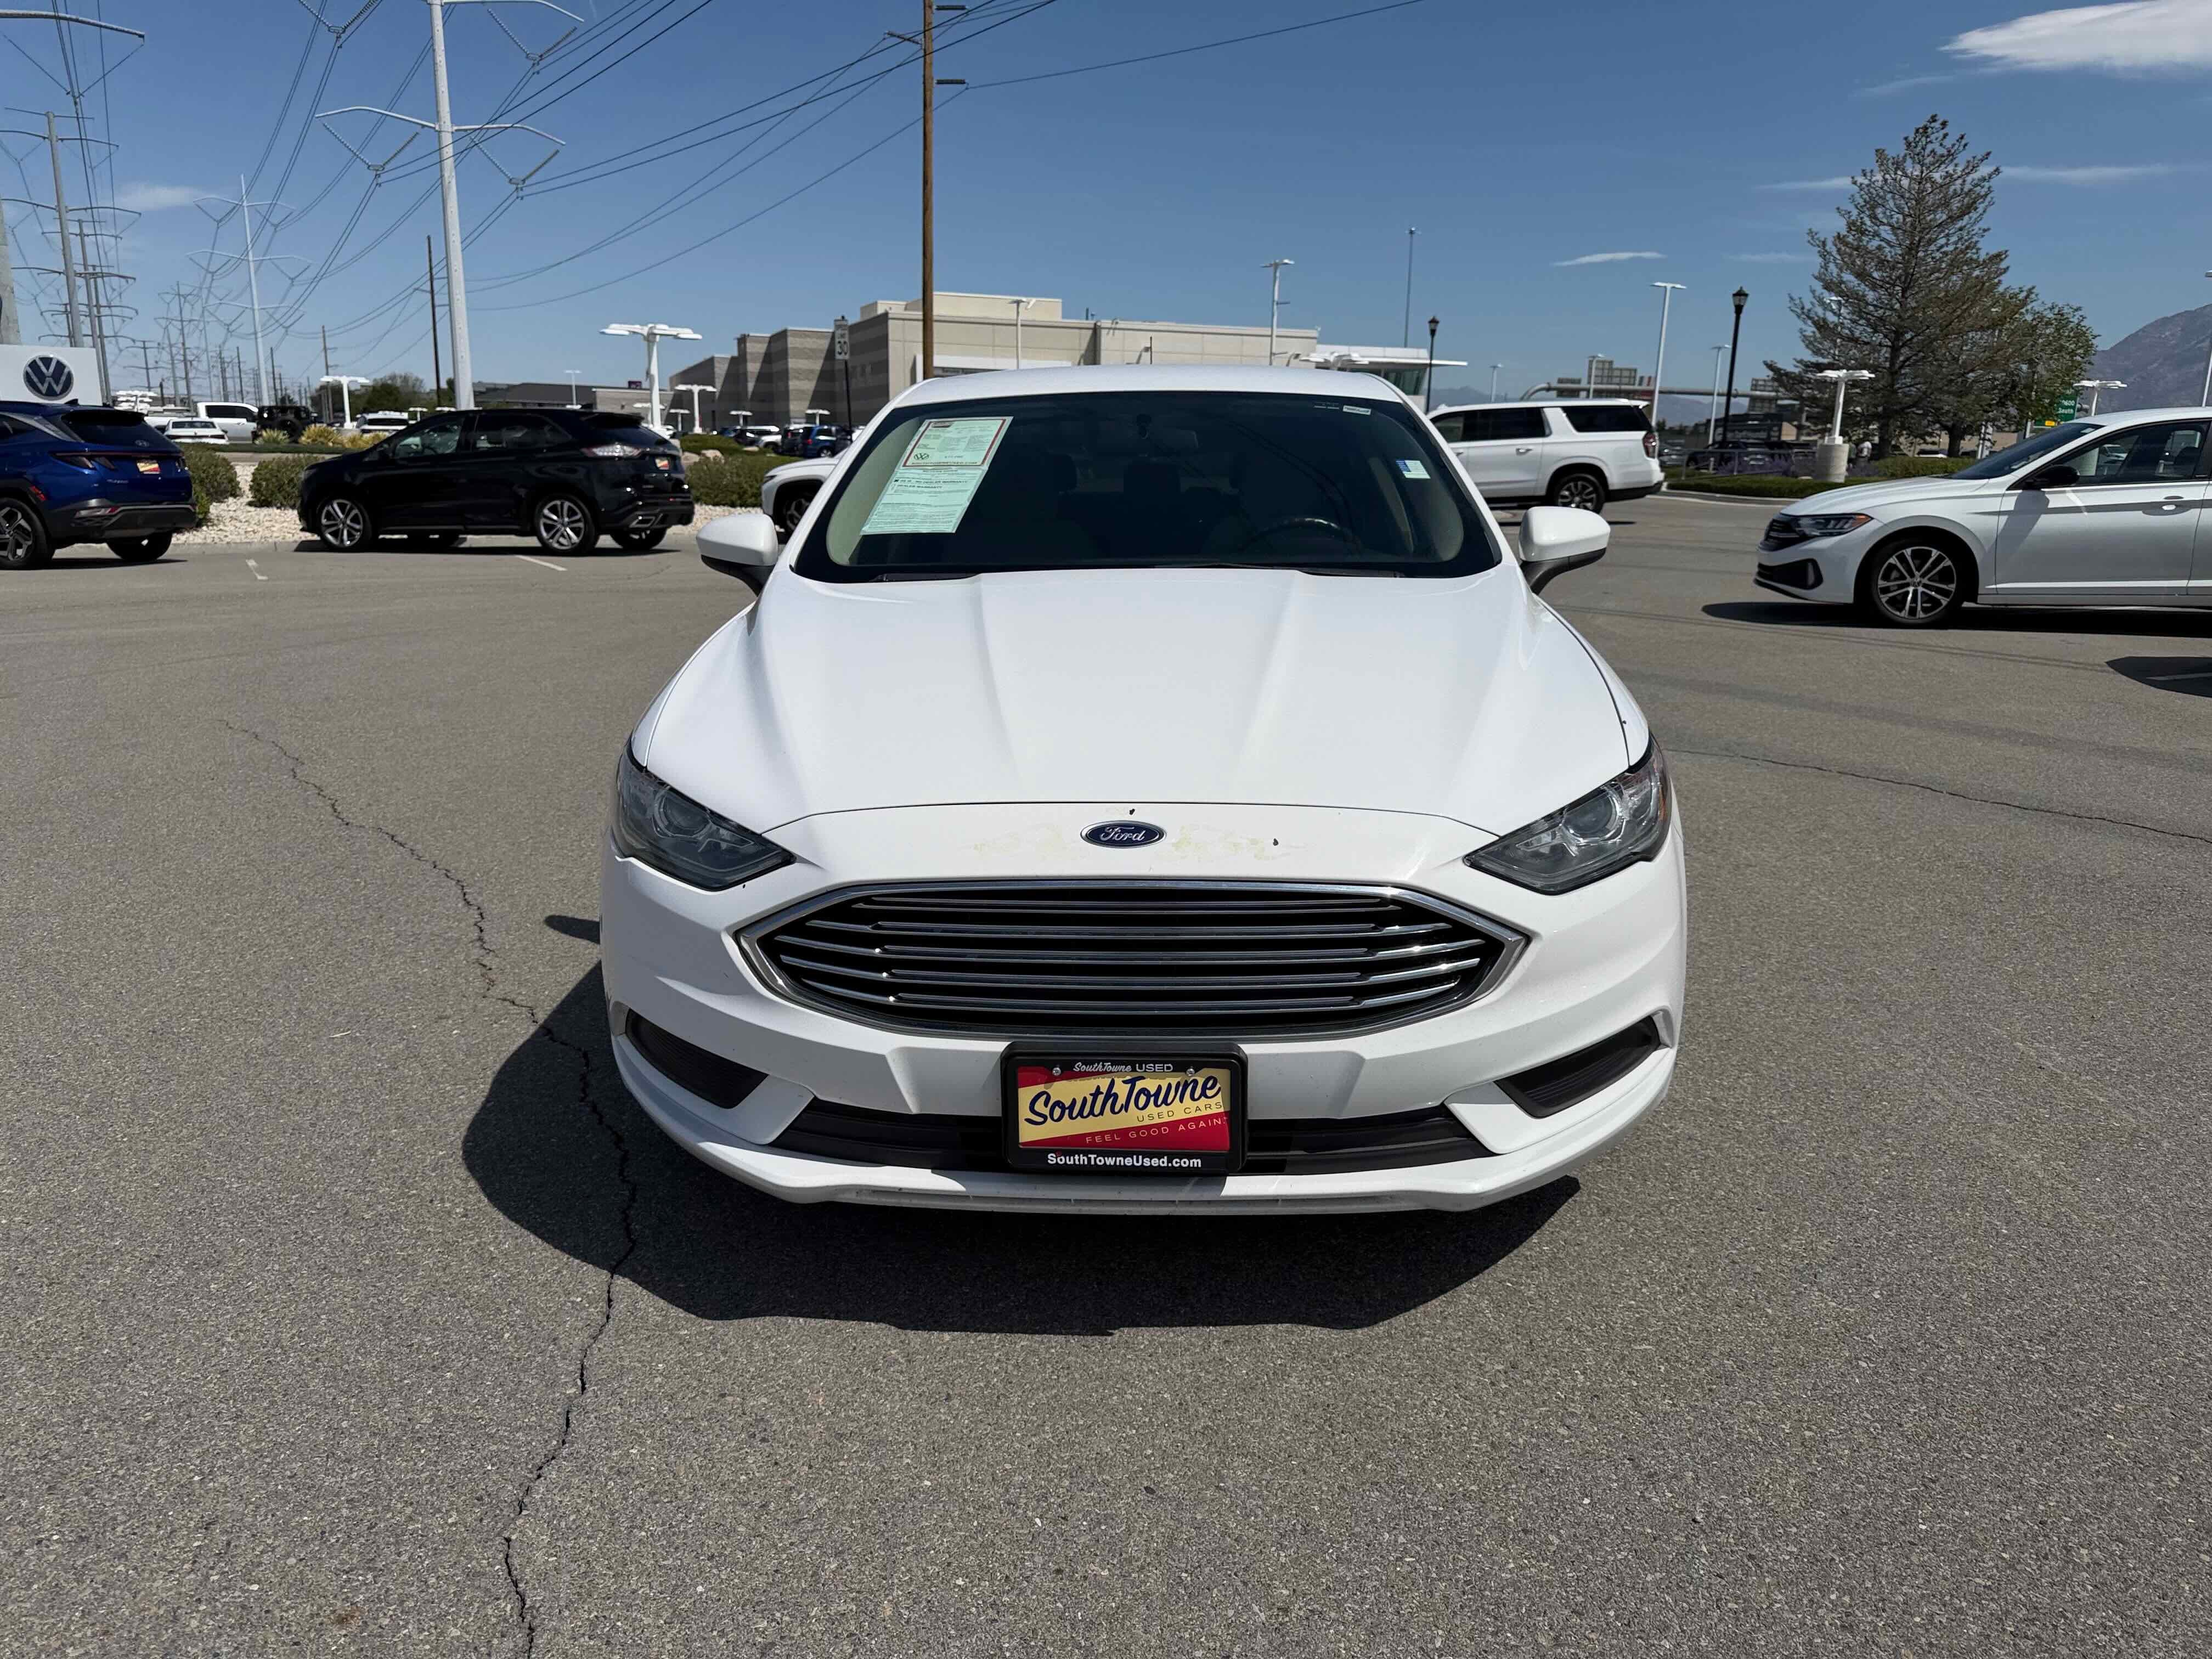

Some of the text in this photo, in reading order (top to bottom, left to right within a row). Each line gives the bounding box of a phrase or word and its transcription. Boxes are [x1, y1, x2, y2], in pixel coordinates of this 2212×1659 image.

[838, 341, 848, 356] 30
[1101, 826, 1146, 840] Ford
[1073, 1062, 1173, 1072] SouthTowne USED
[1024, 1075, 1221, 1126] SouthTowne
[1137, 1102, 1223, 1122] USED CARS
[1086, 1132, 1121, 1144] FEEL
[1129, 1126, 1169, 1139] GOOD
[1048, 1153, 1201, 1168] SouthTowneUsed.com
